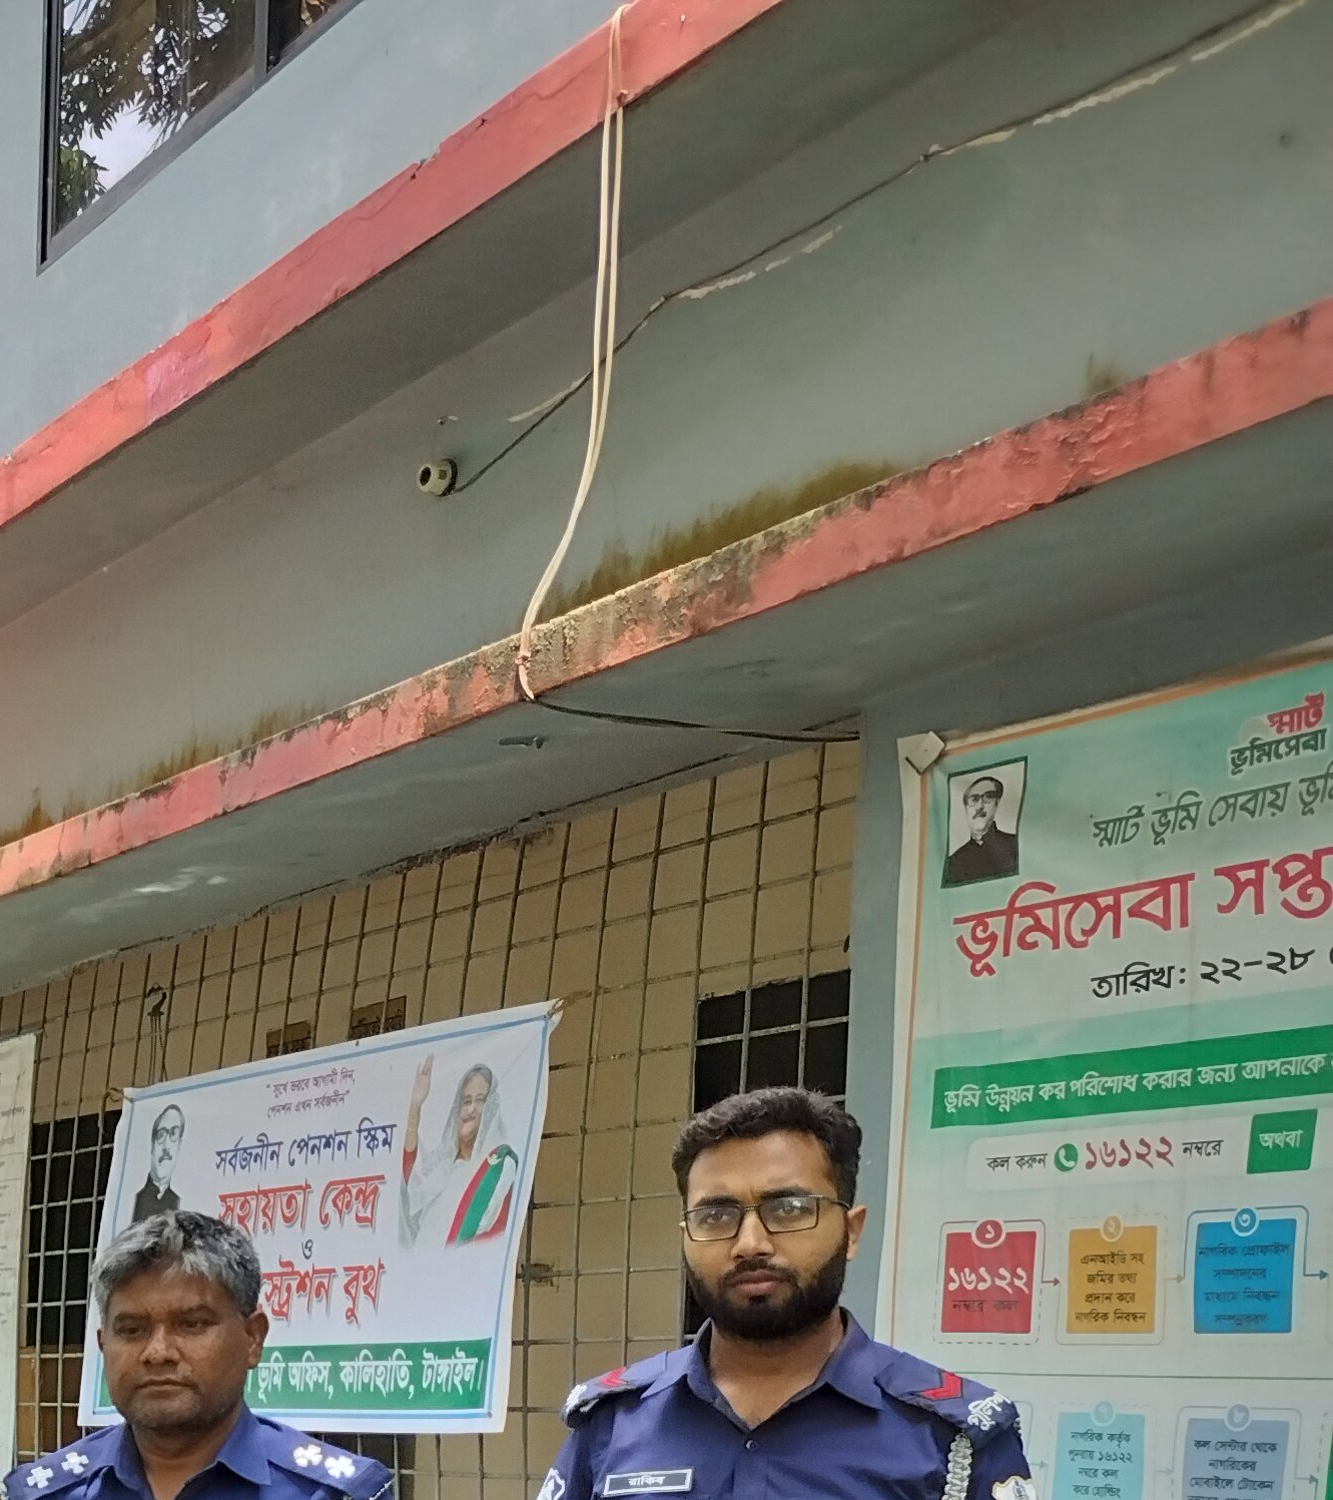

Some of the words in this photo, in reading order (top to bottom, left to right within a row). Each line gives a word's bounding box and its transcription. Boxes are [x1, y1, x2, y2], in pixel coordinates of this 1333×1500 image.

[1230, 728, 1327, 776] ভূমিসেবা
[1150, 791, 1202, 846] ভূমি
[1207, 780, 1292, 828] সেবায়
[952, 873, 1195, 978] ভূমিসেবা
[1213, 846, 1333, 920] সপ্ত
[1199, 947, 1315, 984] ২২-২৮
[944, 1084, 982, 1113] ভূমি
[986, 1084, 1035, 1112] উন্নয়ন
[1039, 1081, 1066, 1101] কর
[1069, 1071, 1139, 1097] পরিশোধ
[1143, 1068, 1192, 1091] করার
[1197, 1063, 1238, 1085] জন্য
[1242, 1053, 1327, 1080] আপনাকে
[215, 1132, 283, 1176] সর্বজনীন
[288, 1130, 352, 1167] পেনশন
[356, 1117, 397, 1158] স্কিম
[986, 1156, 1011, 1172] কল
[1015, 1153, 1048, 1170] করুন
[1084, 1136, 1175, 1170] ১৬১২২
[1182, 1140, 1224, 1158] নম্বরে
[1258, 1129, 1303, 1150] অথবা
[218, 1177, 312, 1236] সহায়তা
[319, 1174, 386, 1232] কেন্দ্র
[301, 1239, 314, 1260] ও
[343, 1257, 386, 1327] বুথ
[948, 1266, 1030, 1297] ১৬১২২
[1086, 1270, 1114, 1285] জমির
[257, 1351, 286, 1403] ভূমি
[1098, 1451, 1133, 1463] ১৬১২২
